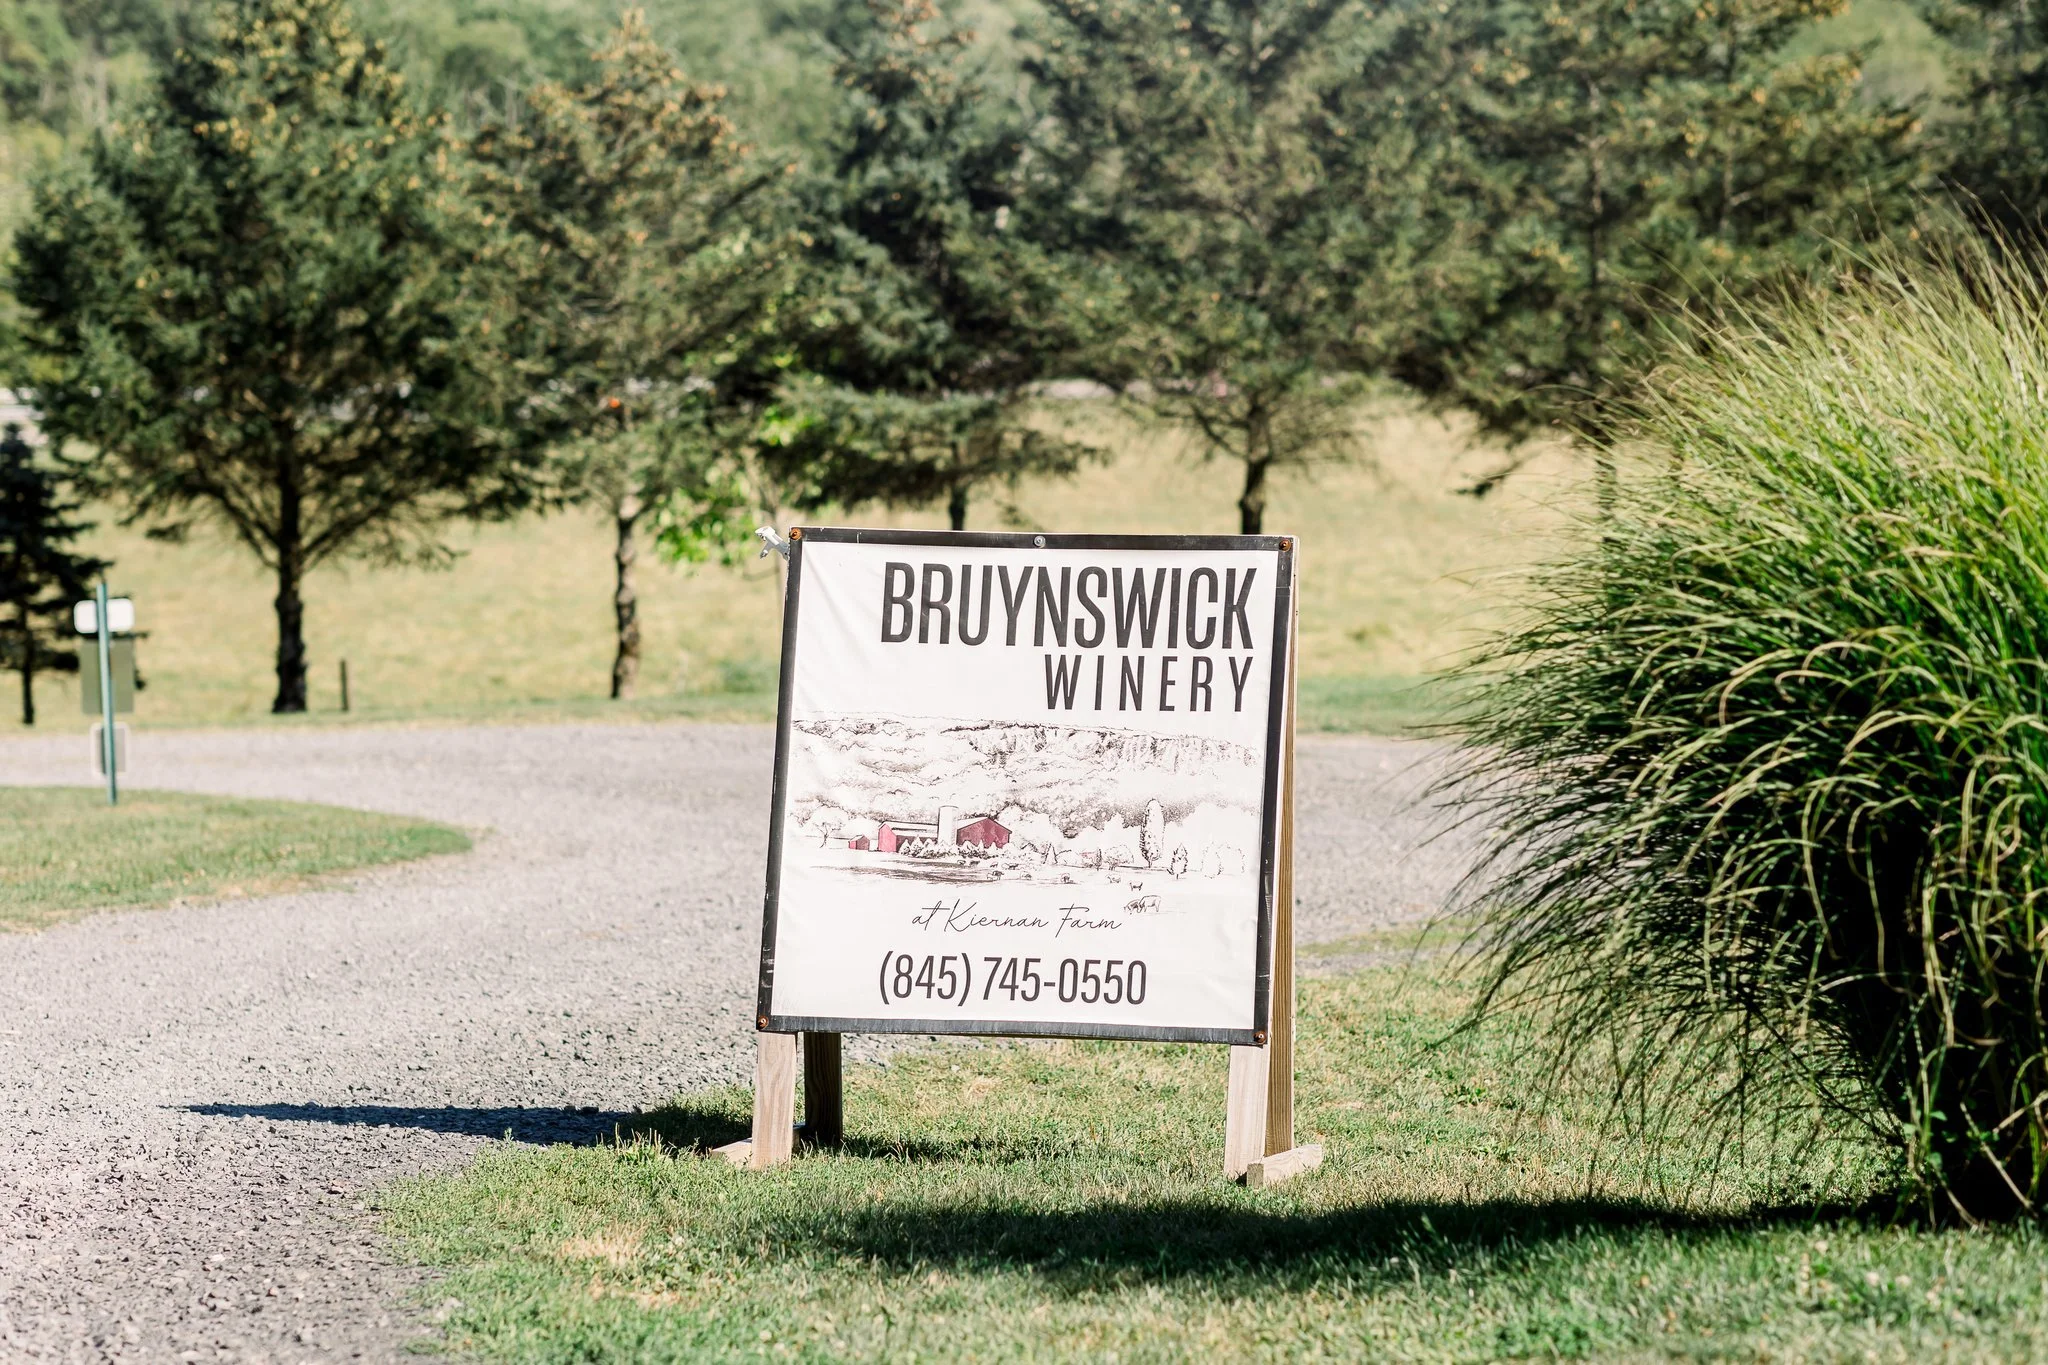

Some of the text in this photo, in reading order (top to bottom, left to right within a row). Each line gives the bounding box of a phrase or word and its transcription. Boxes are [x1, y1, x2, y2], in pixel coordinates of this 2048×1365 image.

[880, 561, 1257, 649] BRUYNSWICK
[1044, 654, 1254, 712] WINERY
[911, 898, 1122, 938] at Kiernan Farm
[879, 950, 1147, 1006] (845) 745-0550
